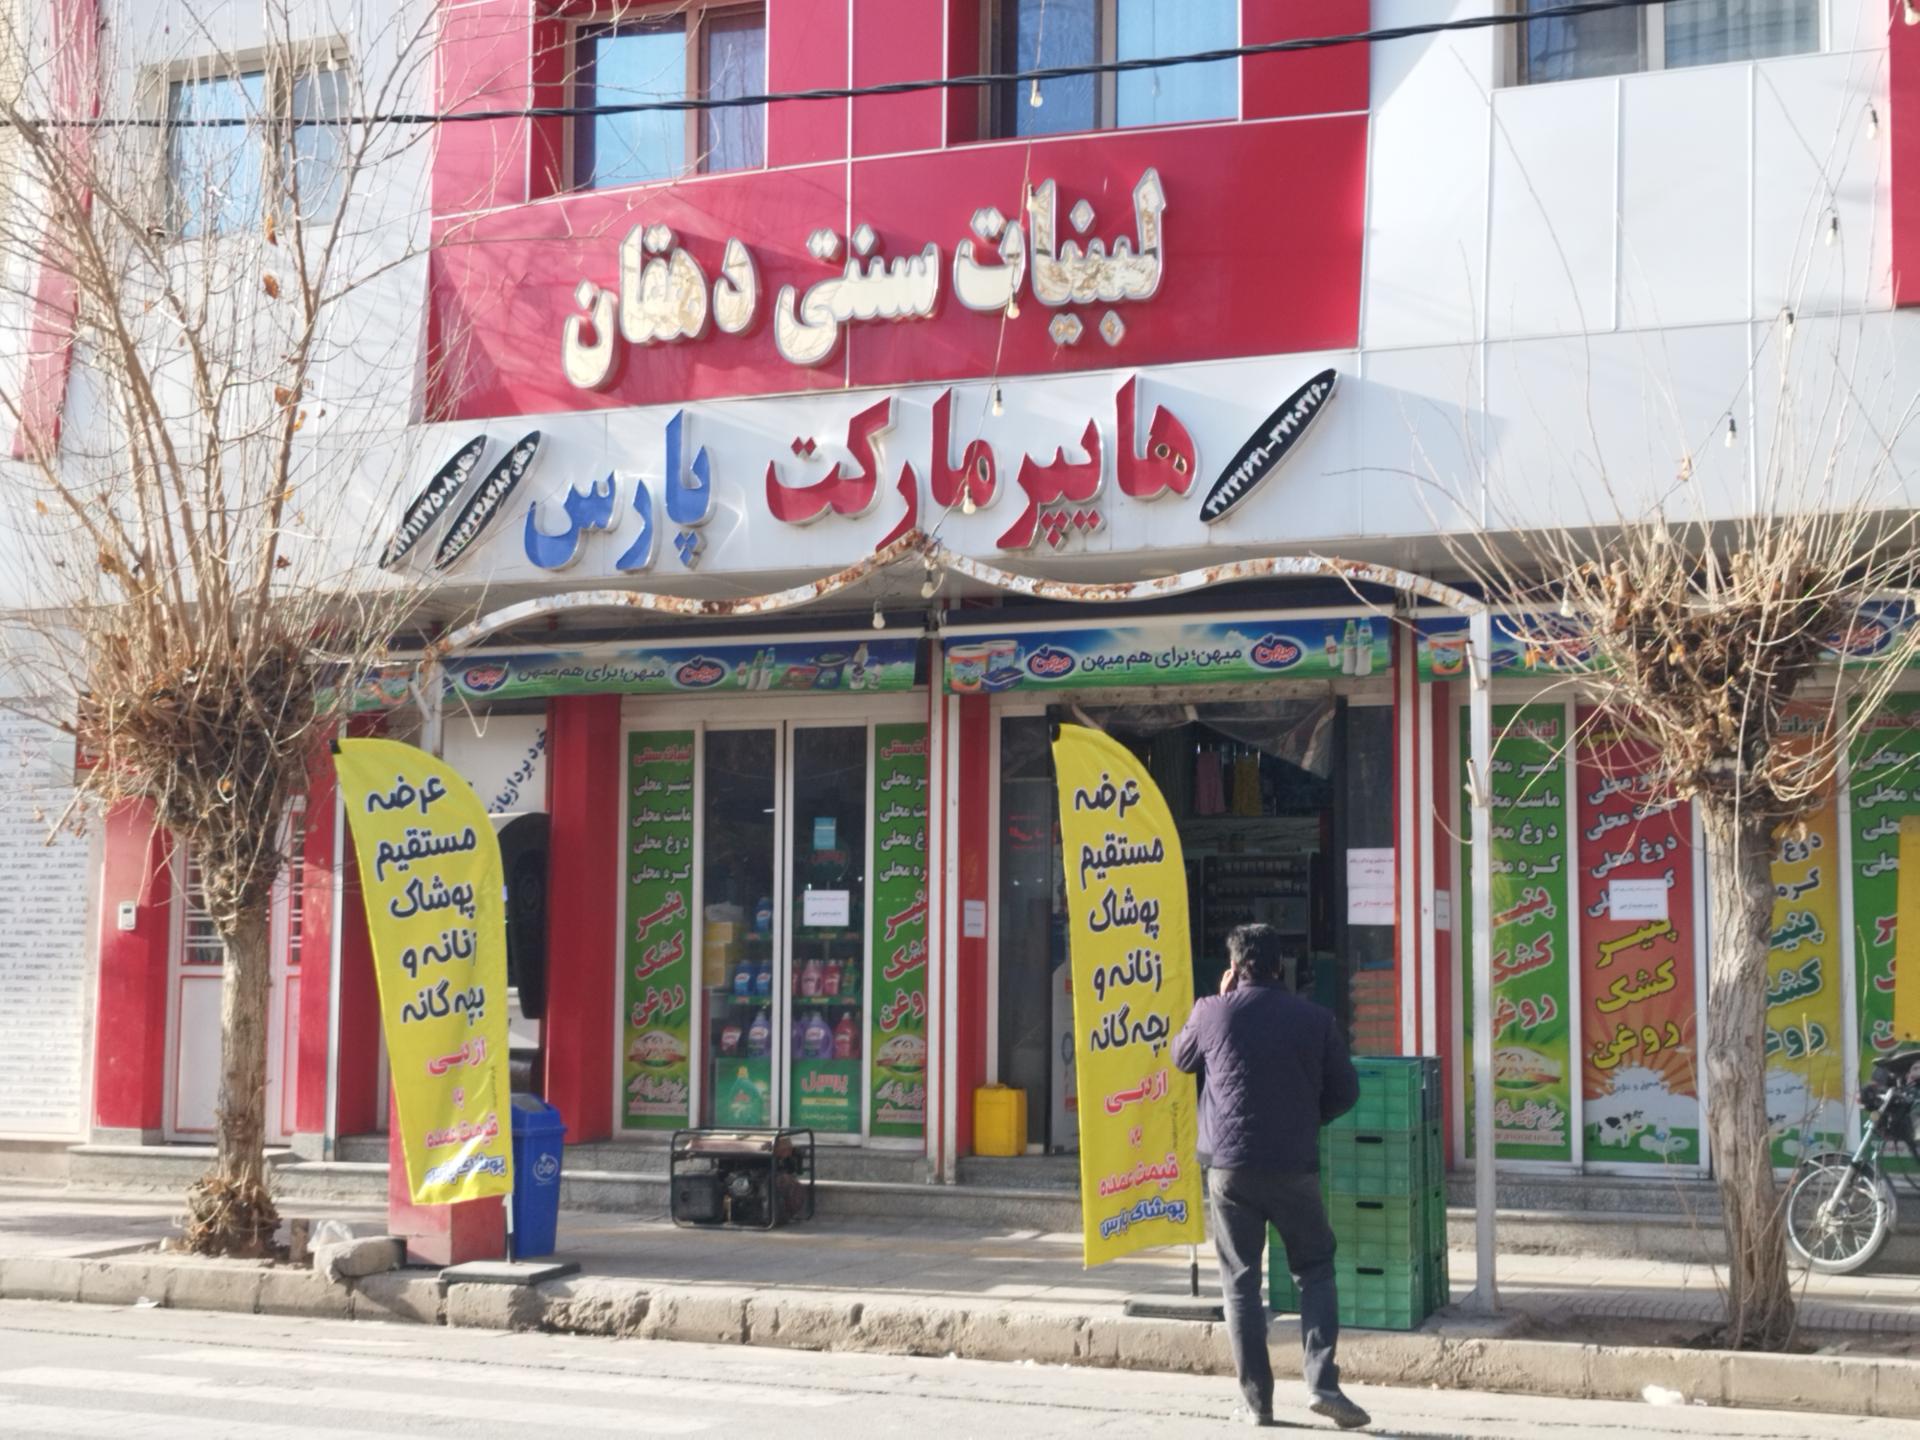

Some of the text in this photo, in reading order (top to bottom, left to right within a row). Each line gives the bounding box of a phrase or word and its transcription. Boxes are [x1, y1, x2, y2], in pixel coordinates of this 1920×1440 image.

[561, 167, 1167, 390] لبنیات سنتی دهقان
[523, 409, 712, 571] پارس
[584, 664, 618, 682] برای
[1081, 654, 1125, 672] میهن
[1155, 646, 1190, 670] برای
[368, 776, 447, 815] عرضه
[634, 775, 662, 797] محلی
[880, 768, 911, 791] محلی
[1075, 773, 1142, 818] عرضه
[1588, 775, 1632, 805] محلی
[880, 801, 911, 823] محلی
[1516, 790, 1561, 808] ماست
[1858, 784, 1908, 808] محلی
[632, 805, 692, 827] ماست محلی
[1519, 817, 1559, 845] دوغ
[1586, 811, 1630, 842] محلی
[1861, 815, 1899, 841] حلی
[376, 828, 476, 882] مستقیم
[633, 833, 662, 854] محلی
[881, 828, 911, 851] محلی
[1640, 834, 1678, 865] دوغ
[632, 864, 660, 884] محلی
[880, 860, 911, 882] محلی
[1081, 834, 1165, 890] مستقیم
[1518, 855, 1561, 880] کره
[1591, 849, 1636, 879] محلی
[1861, 852, 1899, 877] حلی
[390, 875, 476, 919] پوشاک
[1776, 868, 1820, 900] کره
[636, 891, 687, 941] پنیر
[1089, 887, 1159, 940] پوشاک
[1492, 886, 1556, 931] پنی
[1769, 911, 1825, 948] پنی
[402, 948, 418, 978] و
[634, 930, 685, 981] کشک
[1093, 948, 1163, 1002] زنانه و
[1595, 958, 1677, 1014] کشک
[1766, 958, 1822, 1009] کش
[401, 980, 451, 1023] گانه
[631, 984, 686, 1029] روغن
[879, 988, 925, 1032] وغن
[1492, 993, 1559, 1041] روغ
[1091, 1004, 1171, 1058] بچه گانه
[1592, 1021, 1682, 1071] روغن
[1152, 1069, 1168, 1101] از
[1134, 1152, 1180, 1189] قیمت
[1129, 1196, 1188, 1224] پوشاک
